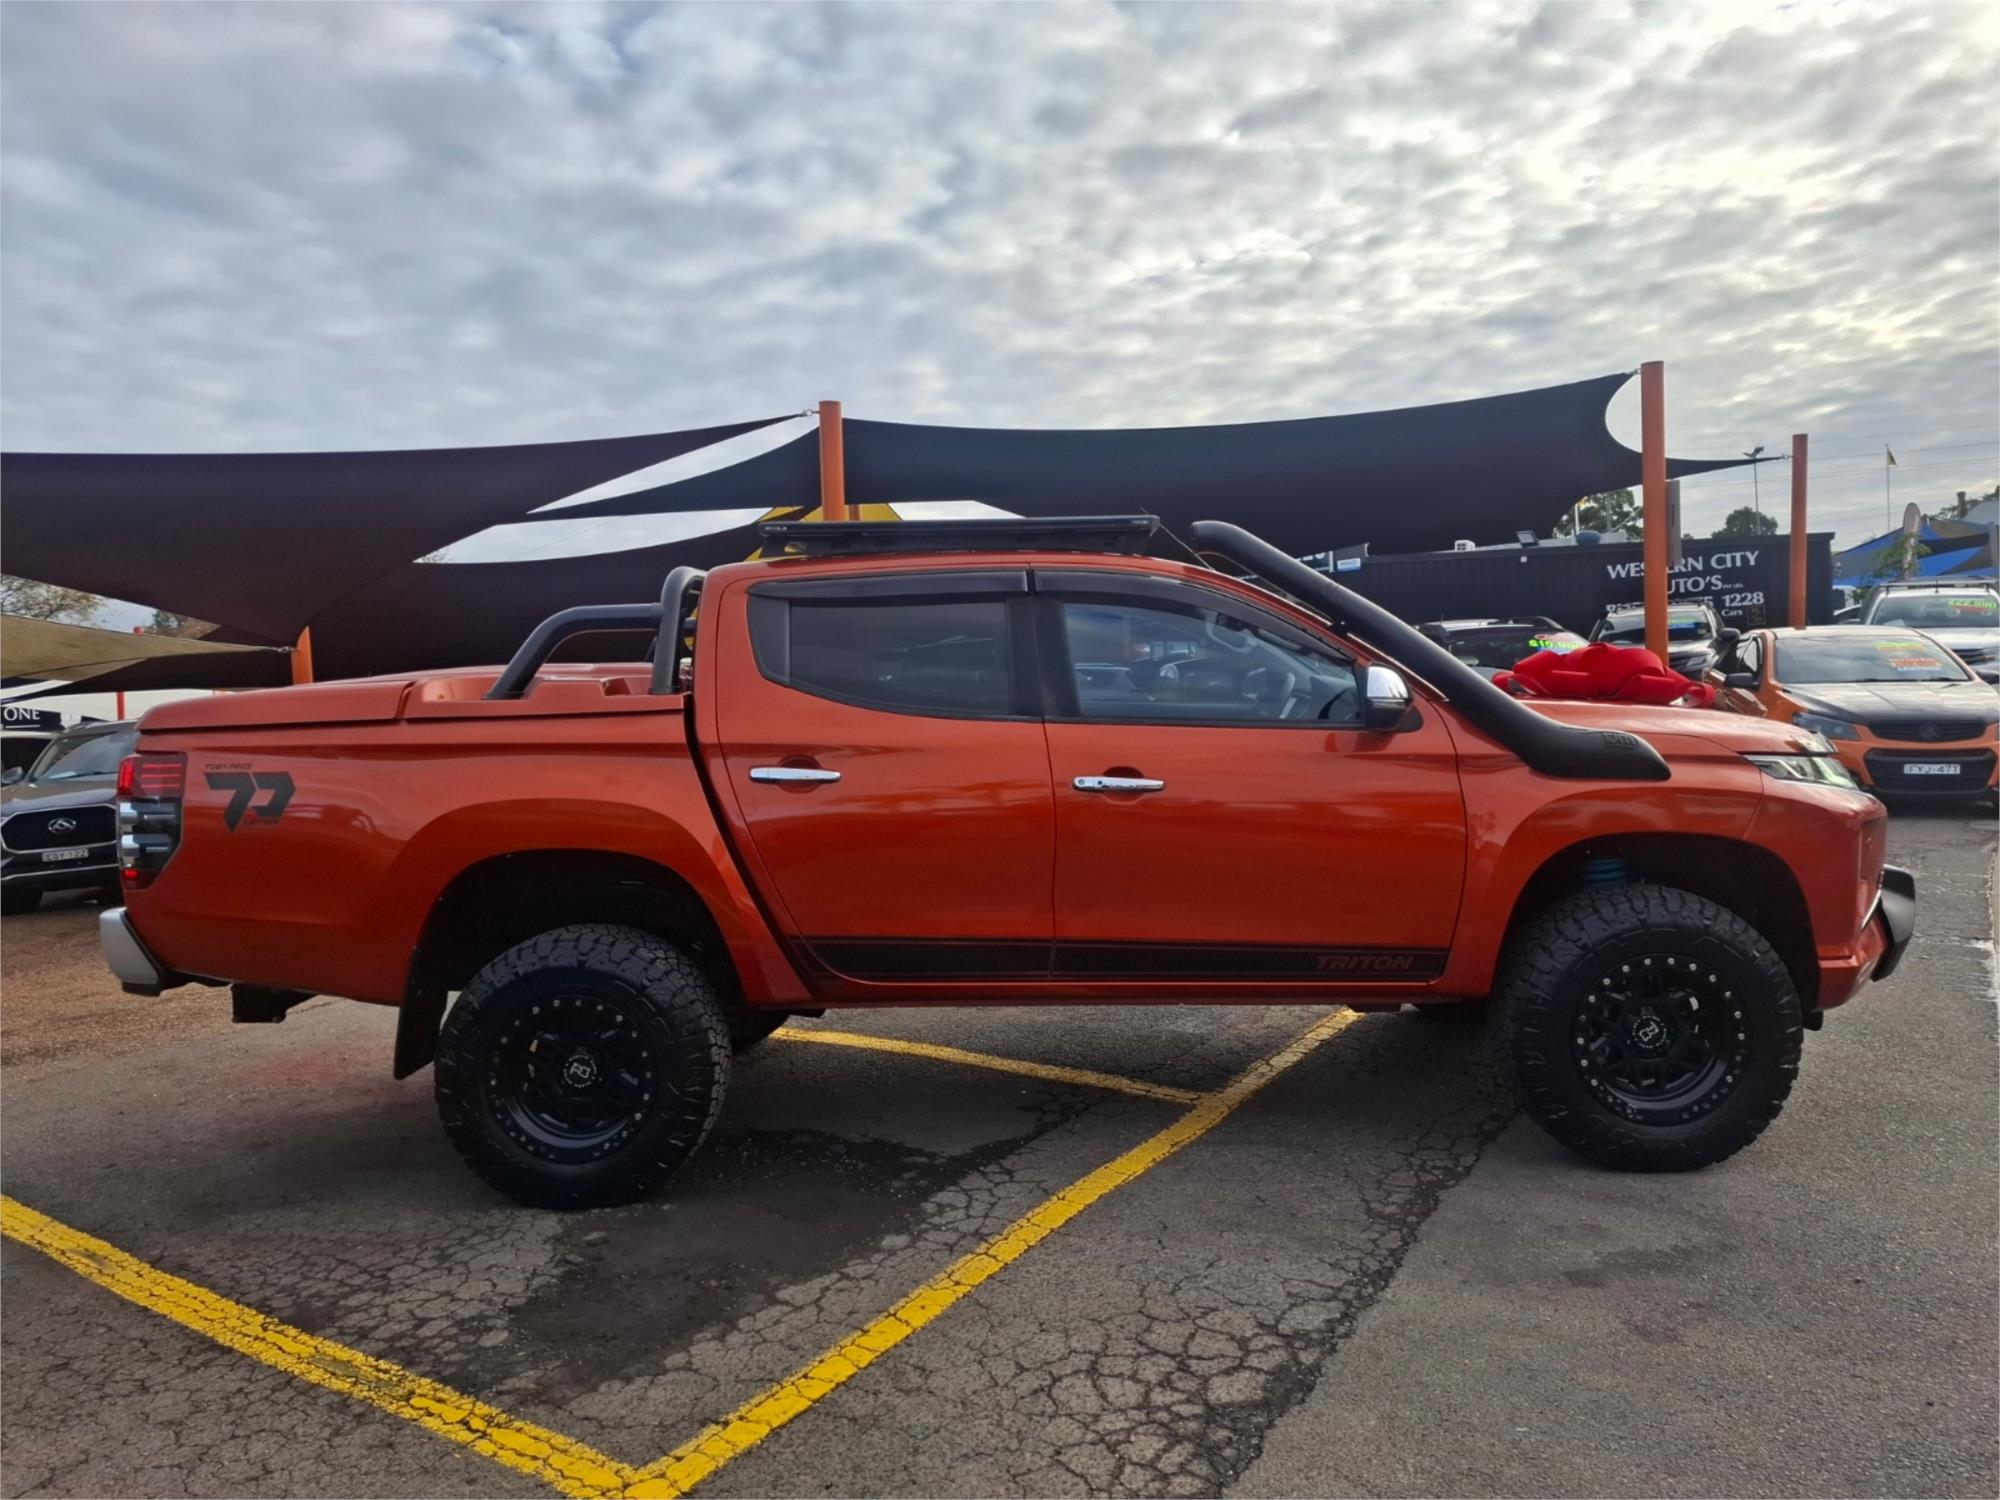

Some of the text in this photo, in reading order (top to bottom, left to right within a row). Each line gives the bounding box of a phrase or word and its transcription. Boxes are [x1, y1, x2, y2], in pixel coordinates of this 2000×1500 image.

[1710, 550, 1759, 570] CITY
[1721, 591, 1764, 607] 1228
[1721, 608, 1743, 617] Cars
[4, 706, 40, 721] ONE
[1316, 955, 1414, 970] TRITON
